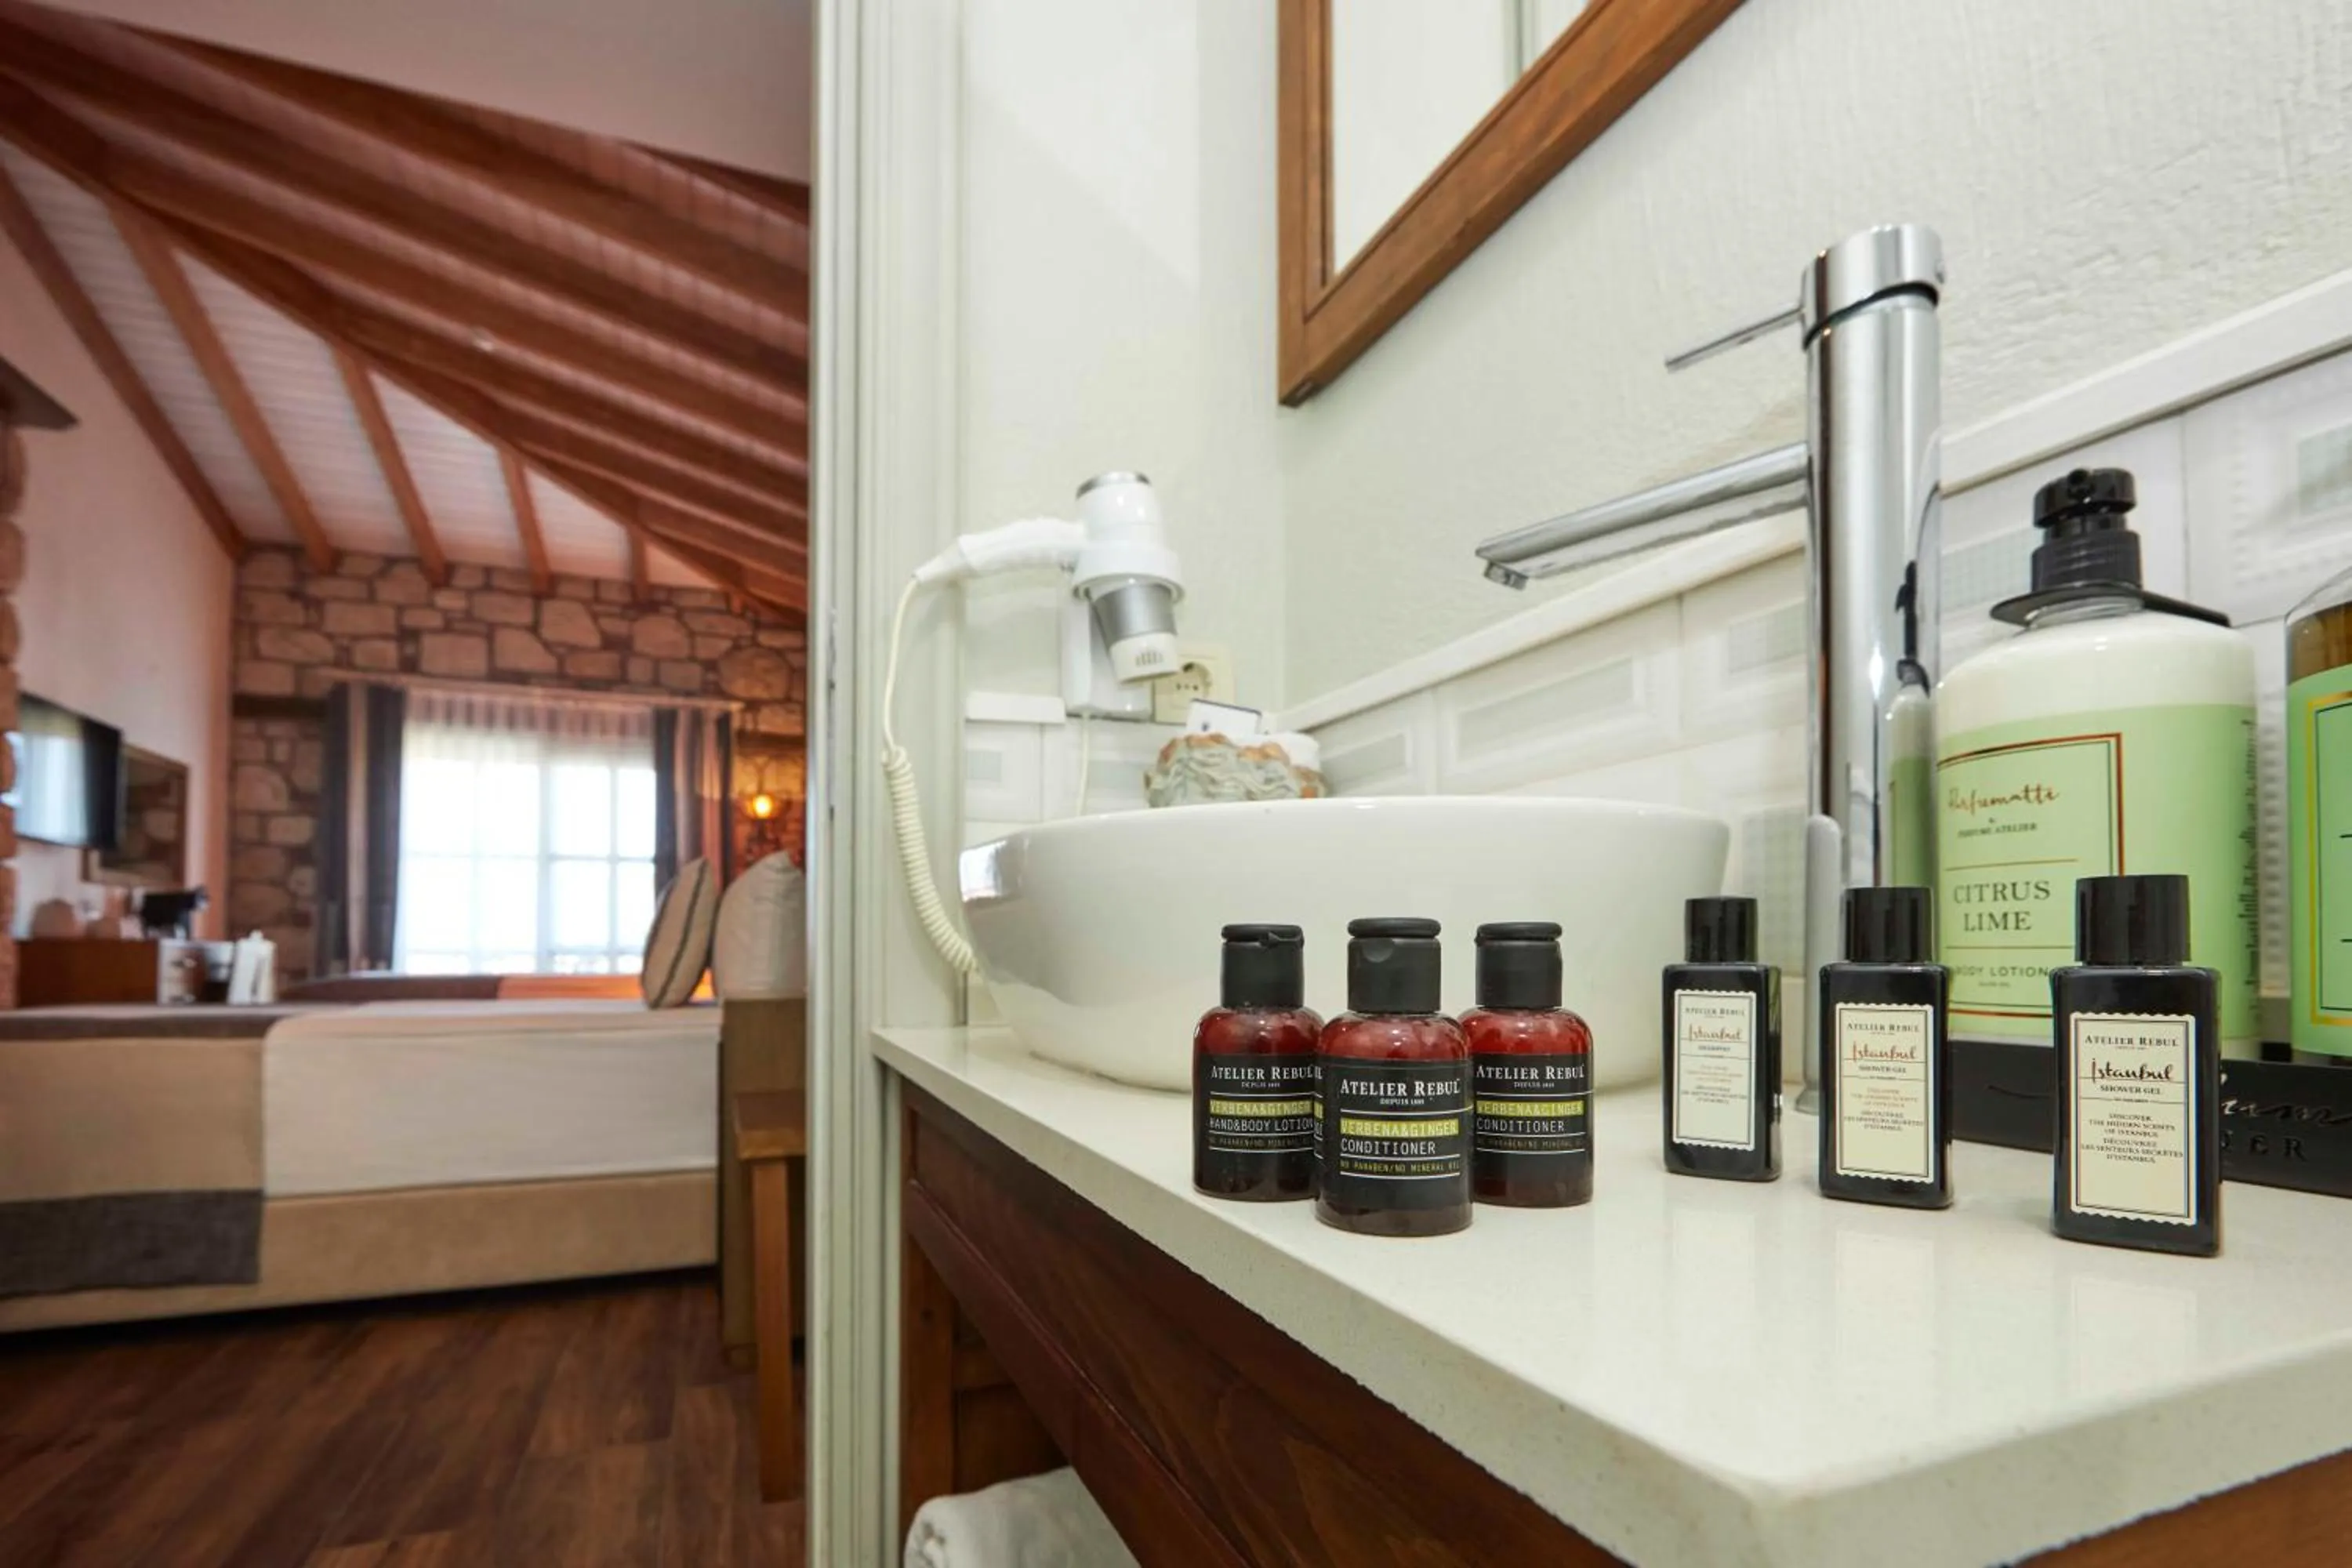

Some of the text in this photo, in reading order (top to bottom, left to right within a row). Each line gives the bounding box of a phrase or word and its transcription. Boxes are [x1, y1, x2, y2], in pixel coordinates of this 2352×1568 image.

[1954, 880, 2051, 903] CITRUS
[1964, 911, 2032, 932] LIME
[1990, 966, 2049, 978] LOTION
[1847, 1022, 1886, 1031] ATELIER
[2085, 1035, 2178, 1047] ATELIER REBUL
[1211, 1065, 1265, 1080] ATELIER
[1271, 1065, 1313, 1080] REBUL
[1476, 1065, 1585, 1080] ATELIER REBUL
[1340, 1078, 1461, 1097] ATELIER REBUL
[2100, 1085, 2141, 1094] SHOWER
[1210, 1117, 1314, 1132] HAND&BODY LOTION
[1340, 1118, 1459, 1137] VERBENA&GINGER
[1476, 1118, 1565, 1133] CONDITIONER
[1341, 1138, 1436, 1156] CONDITIONER
